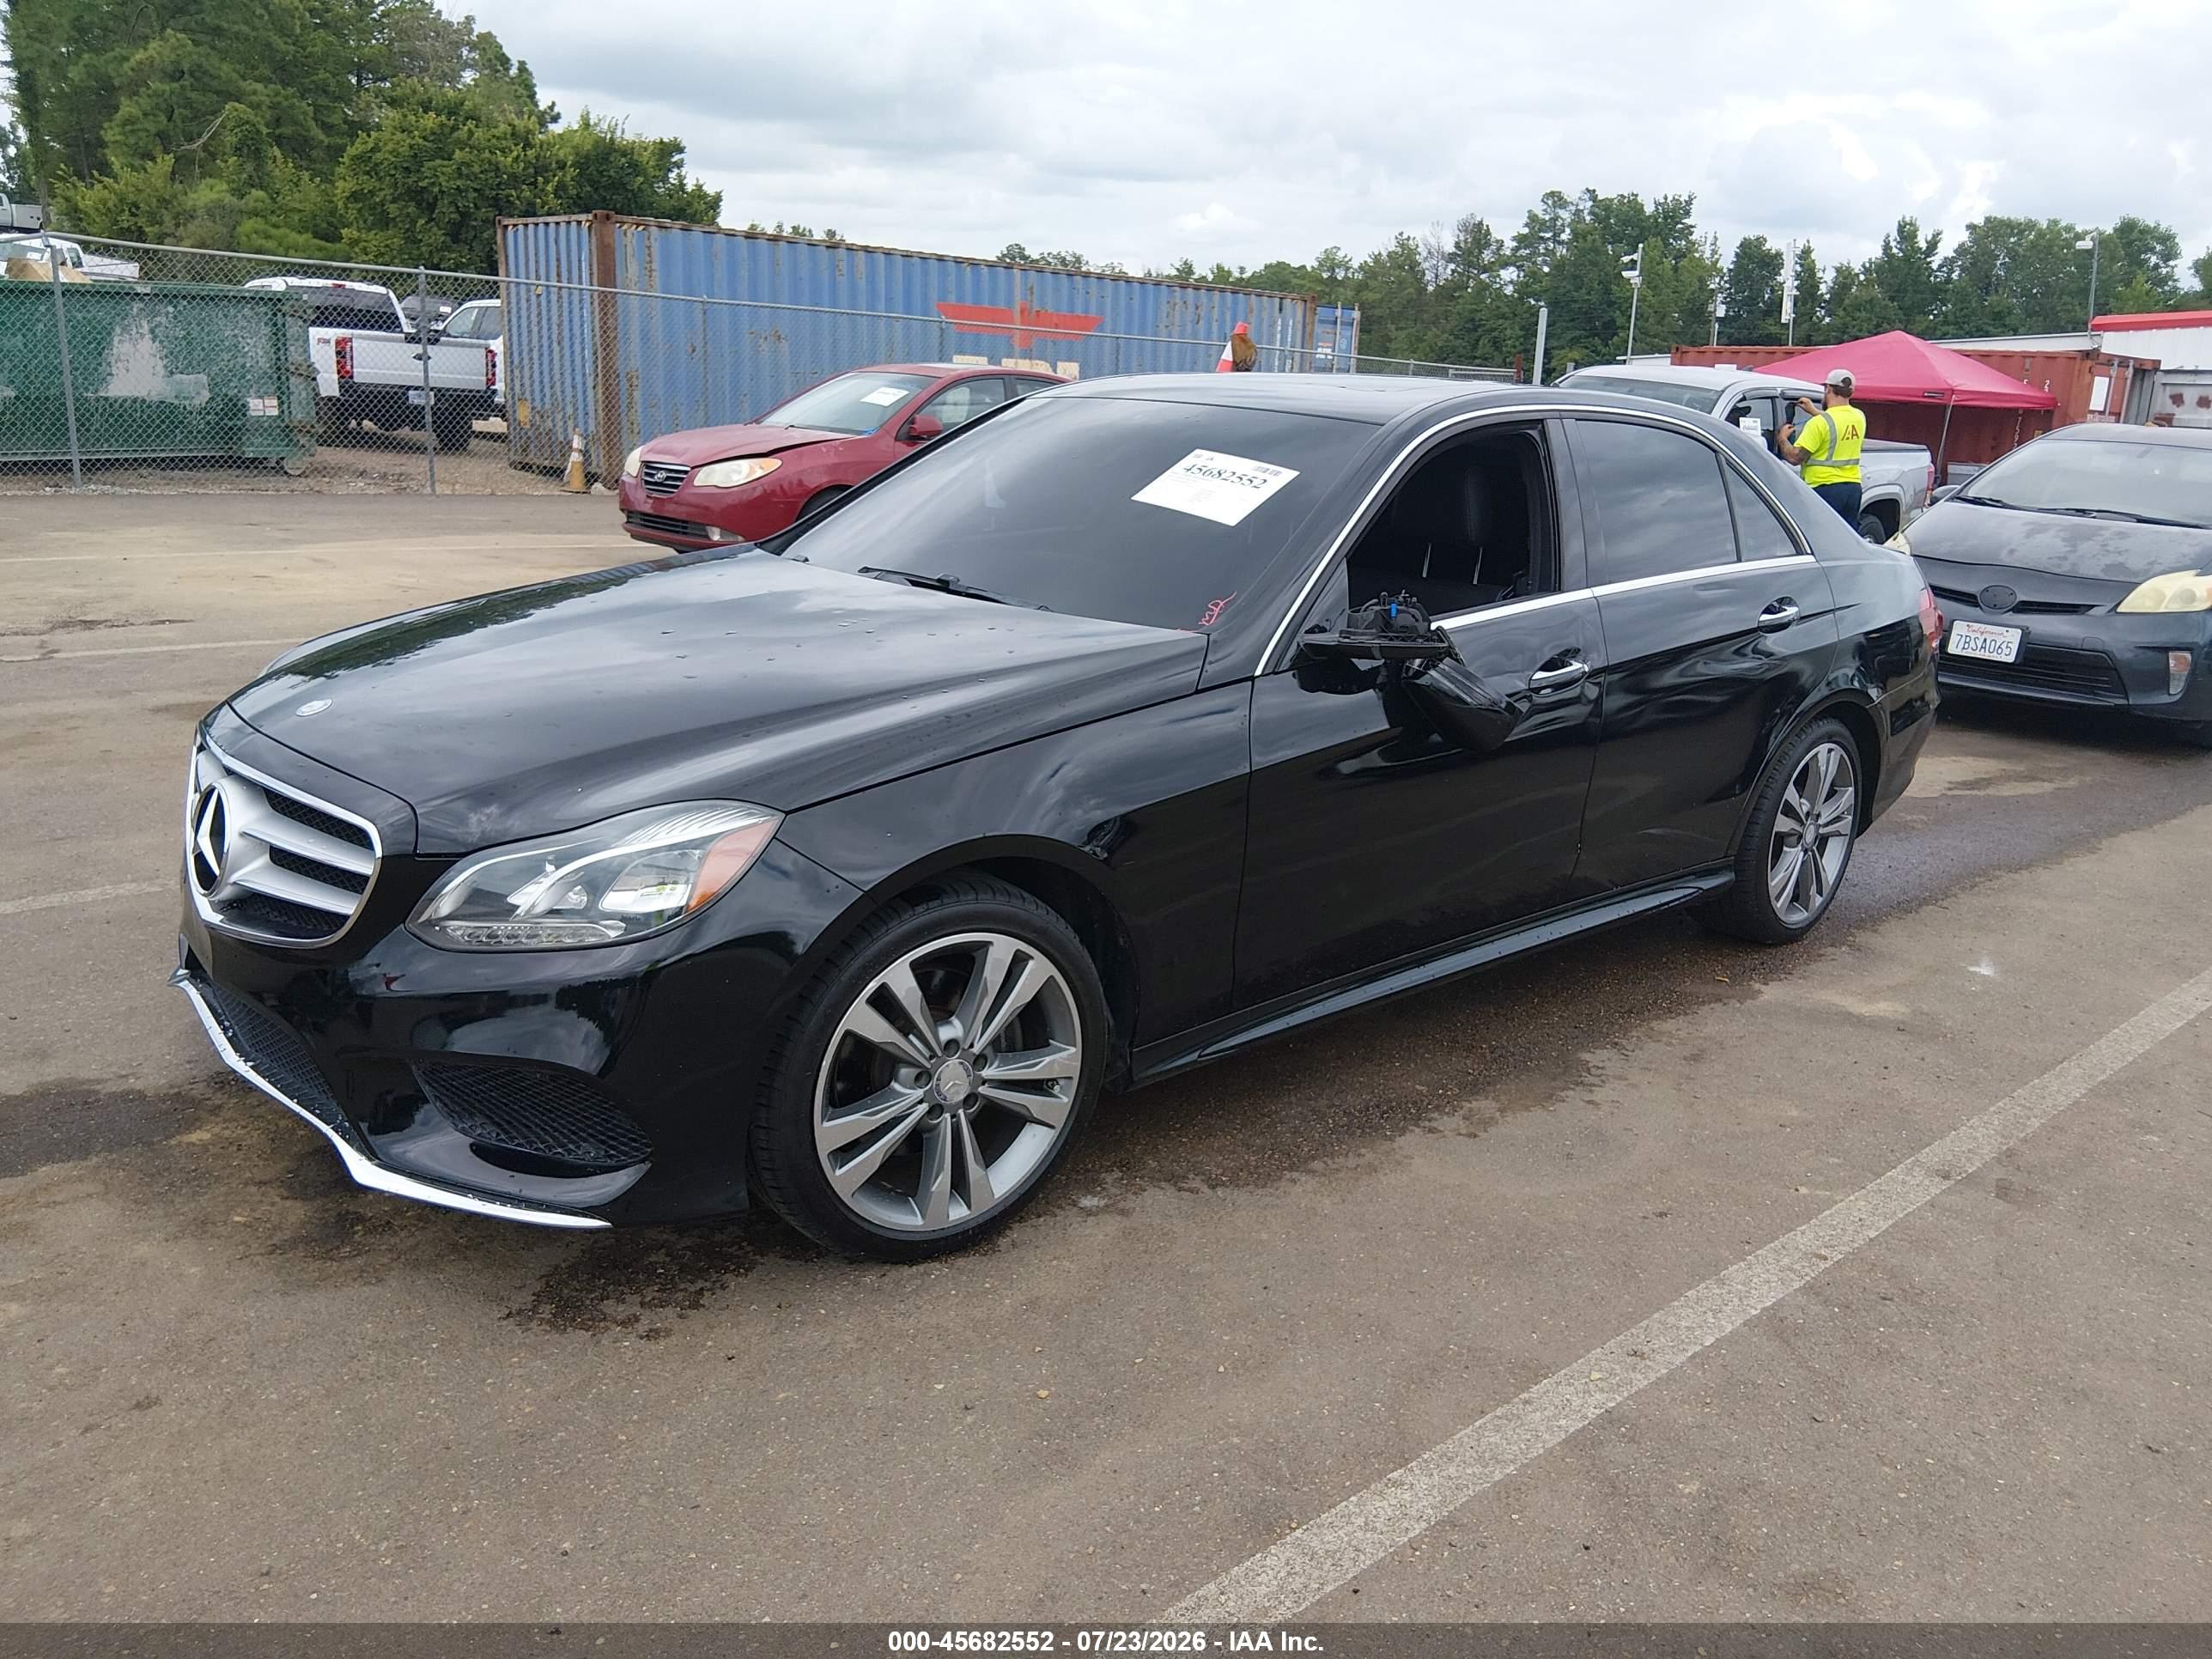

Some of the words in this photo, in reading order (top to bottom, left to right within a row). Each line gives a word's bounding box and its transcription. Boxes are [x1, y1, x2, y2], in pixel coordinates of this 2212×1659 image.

[1183, 463, 1268, 489] 45682552
[1966, 625, 2006, 637] California
[1956, 633, 2014, 657] 7BSA065
